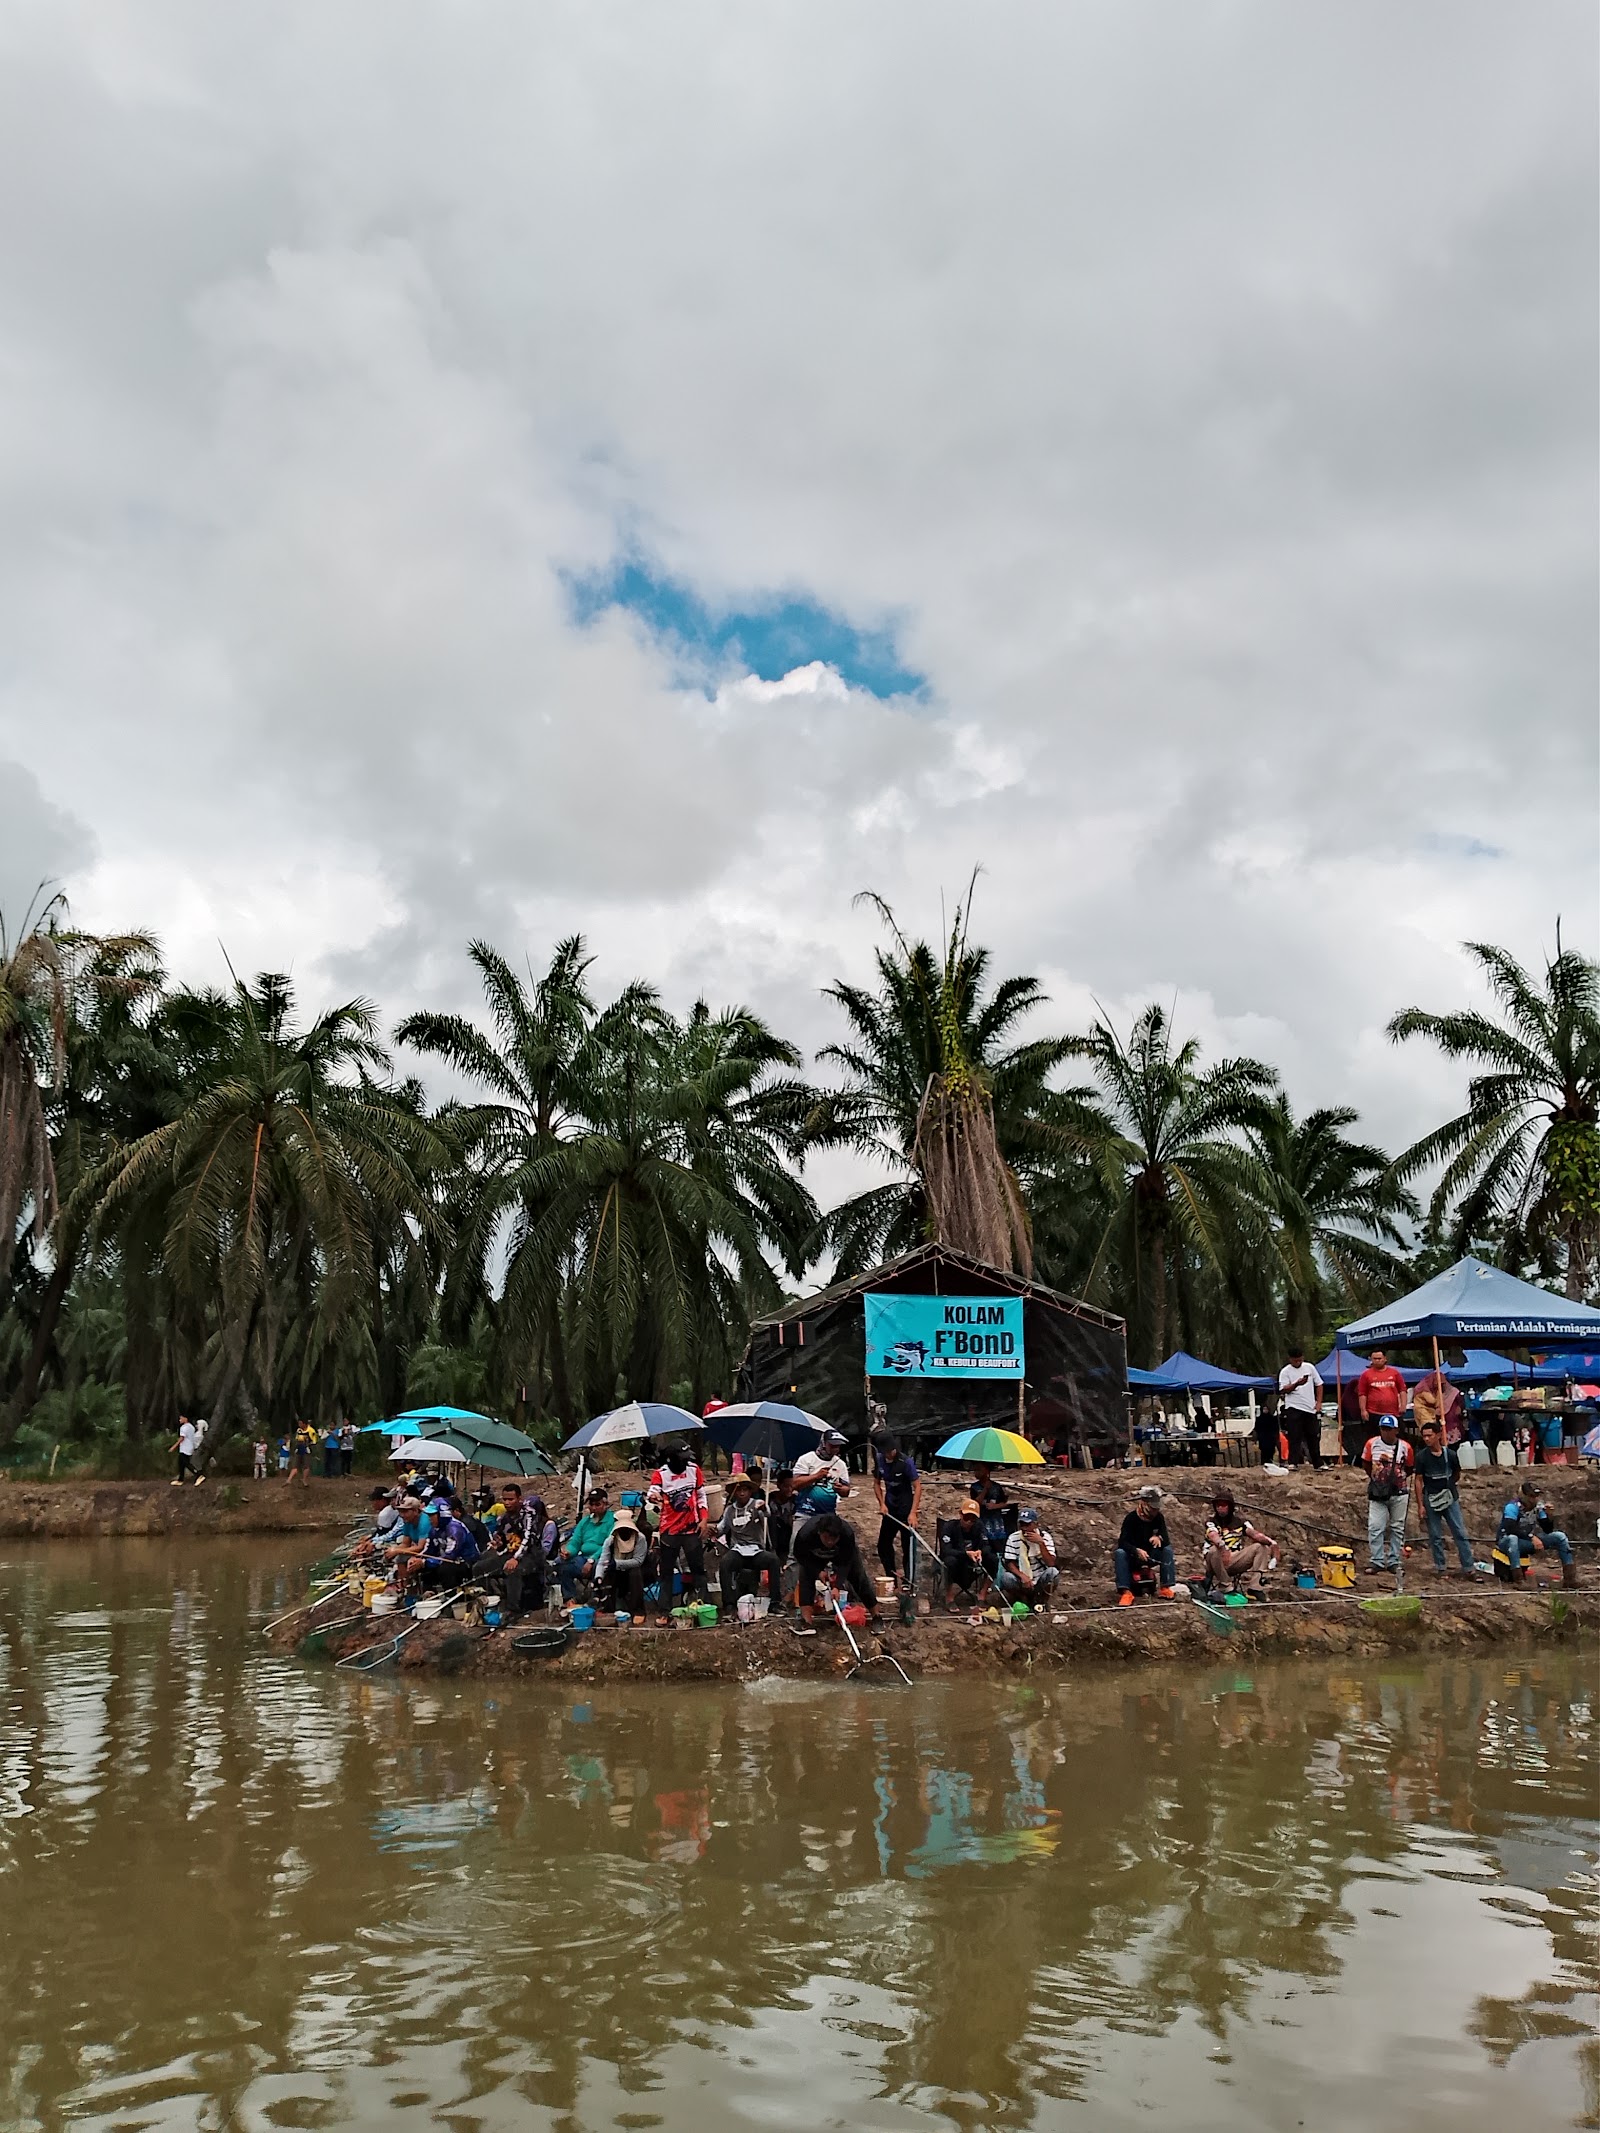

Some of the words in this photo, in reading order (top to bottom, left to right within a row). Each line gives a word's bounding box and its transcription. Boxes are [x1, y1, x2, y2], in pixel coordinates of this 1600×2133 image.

[944, 1306, 1004, 1325] KOLAM
[1456, 1320, 1507, 1332] Pertanian
[1508, 1320, 1546, 1333] Adalah
[935, 1330, 1014, 1355] F'BonD
[978, 1359, 1017, 1367] BEAUFORT
